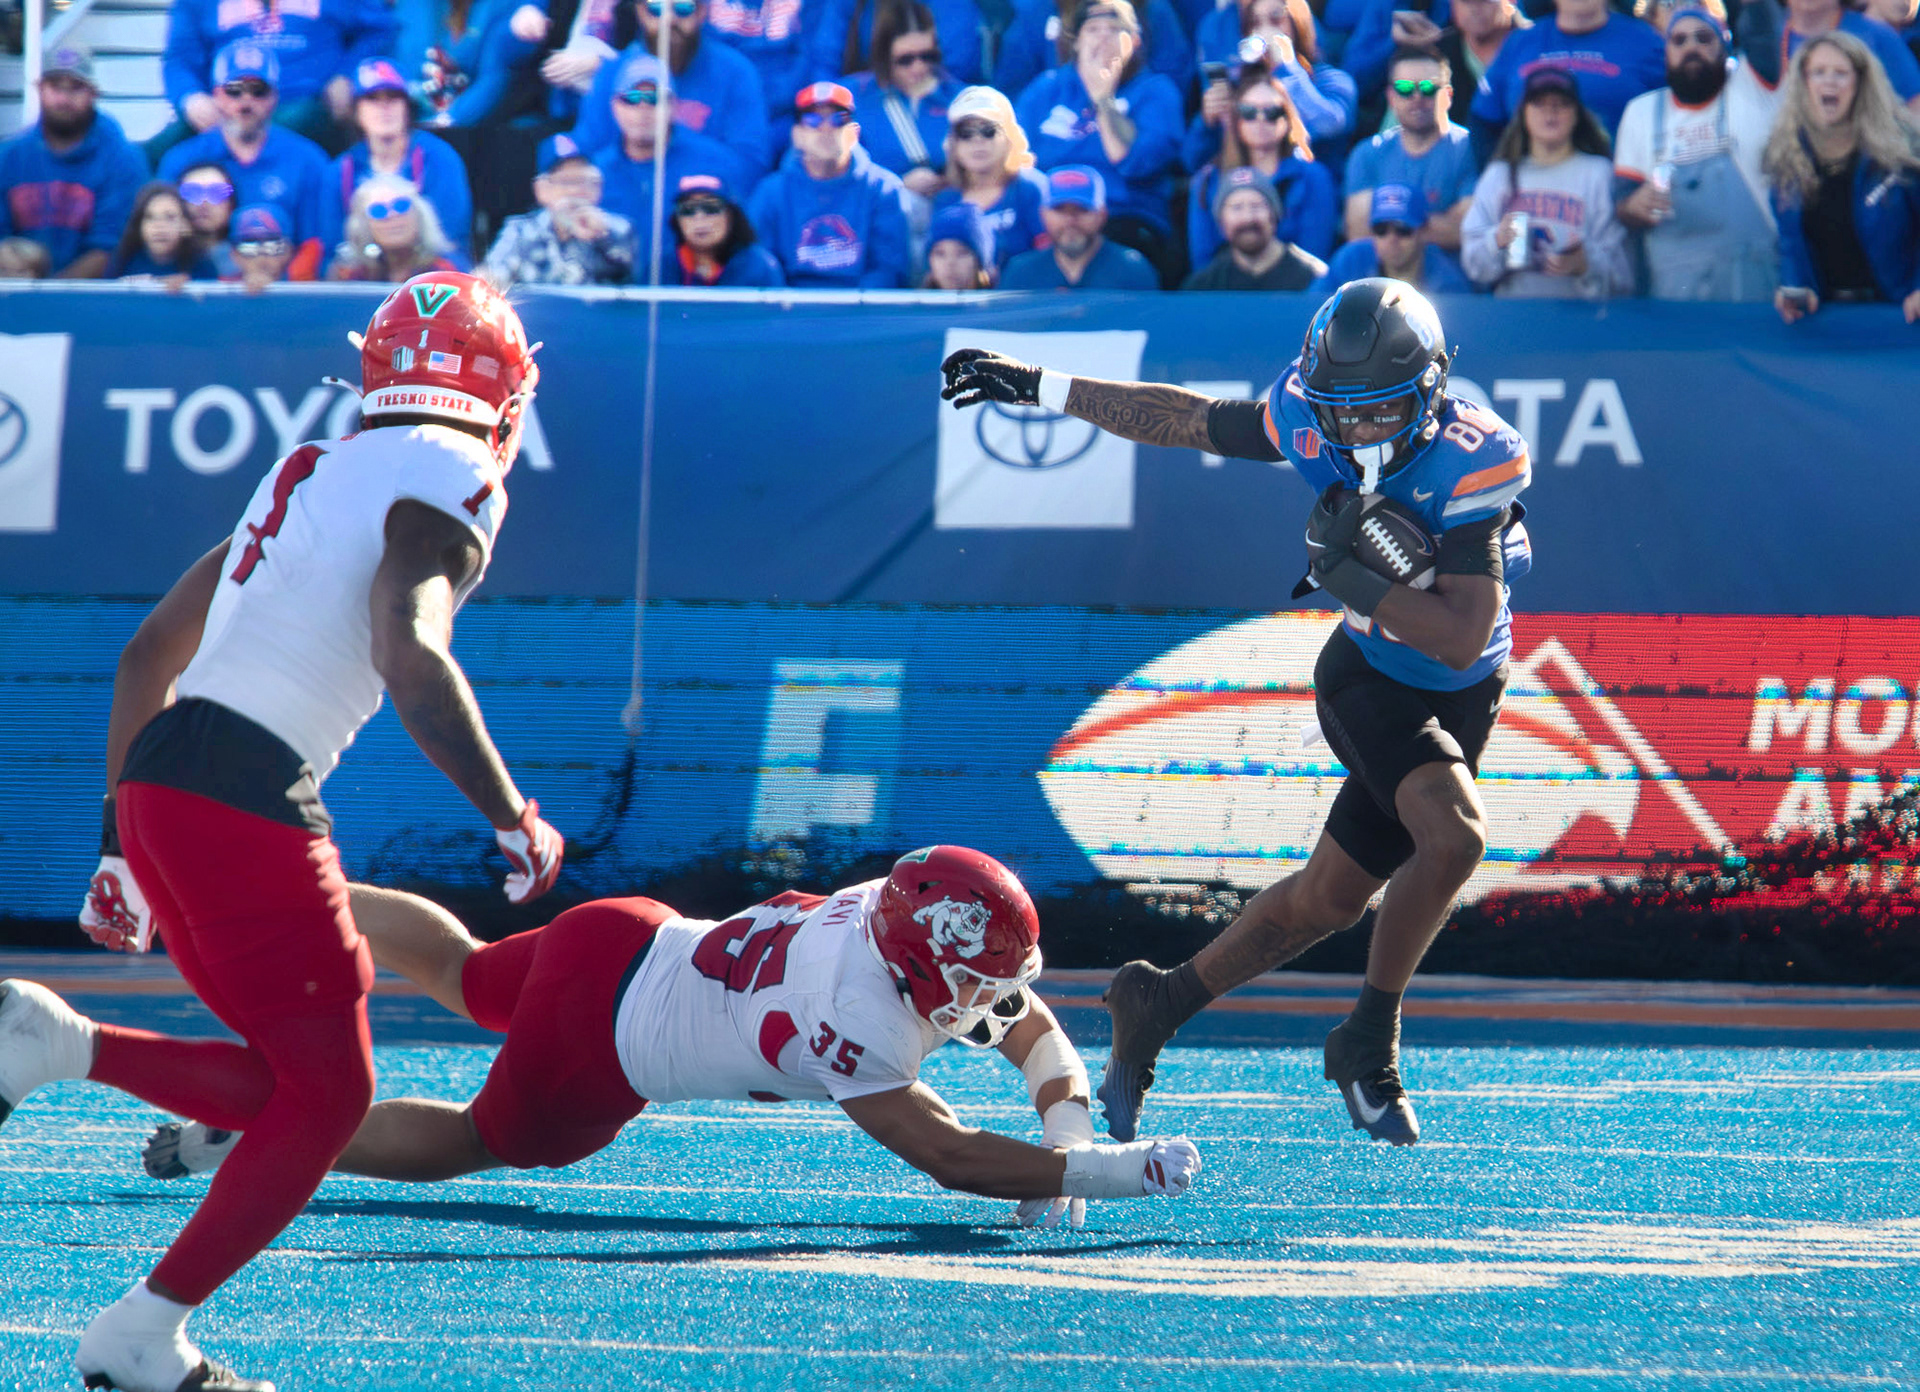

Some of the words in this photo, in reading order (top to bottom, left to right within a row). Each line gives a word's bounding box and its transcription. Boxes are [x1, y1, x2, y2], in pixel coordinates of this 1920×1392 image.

[409, 282, 461, 319] V
[418, 328, 429, 349] 1
[377, 393, 427, 408] FRESNO
[430, 394, 474, 414] STATE
[105, 385, 555, 475] TOY
[461, 480, 494, 517] 1
[1748, 674, 1920, 755] MO
[821, 891, 865, 927] AVI
[808, 1020, 866, 1078] 35
